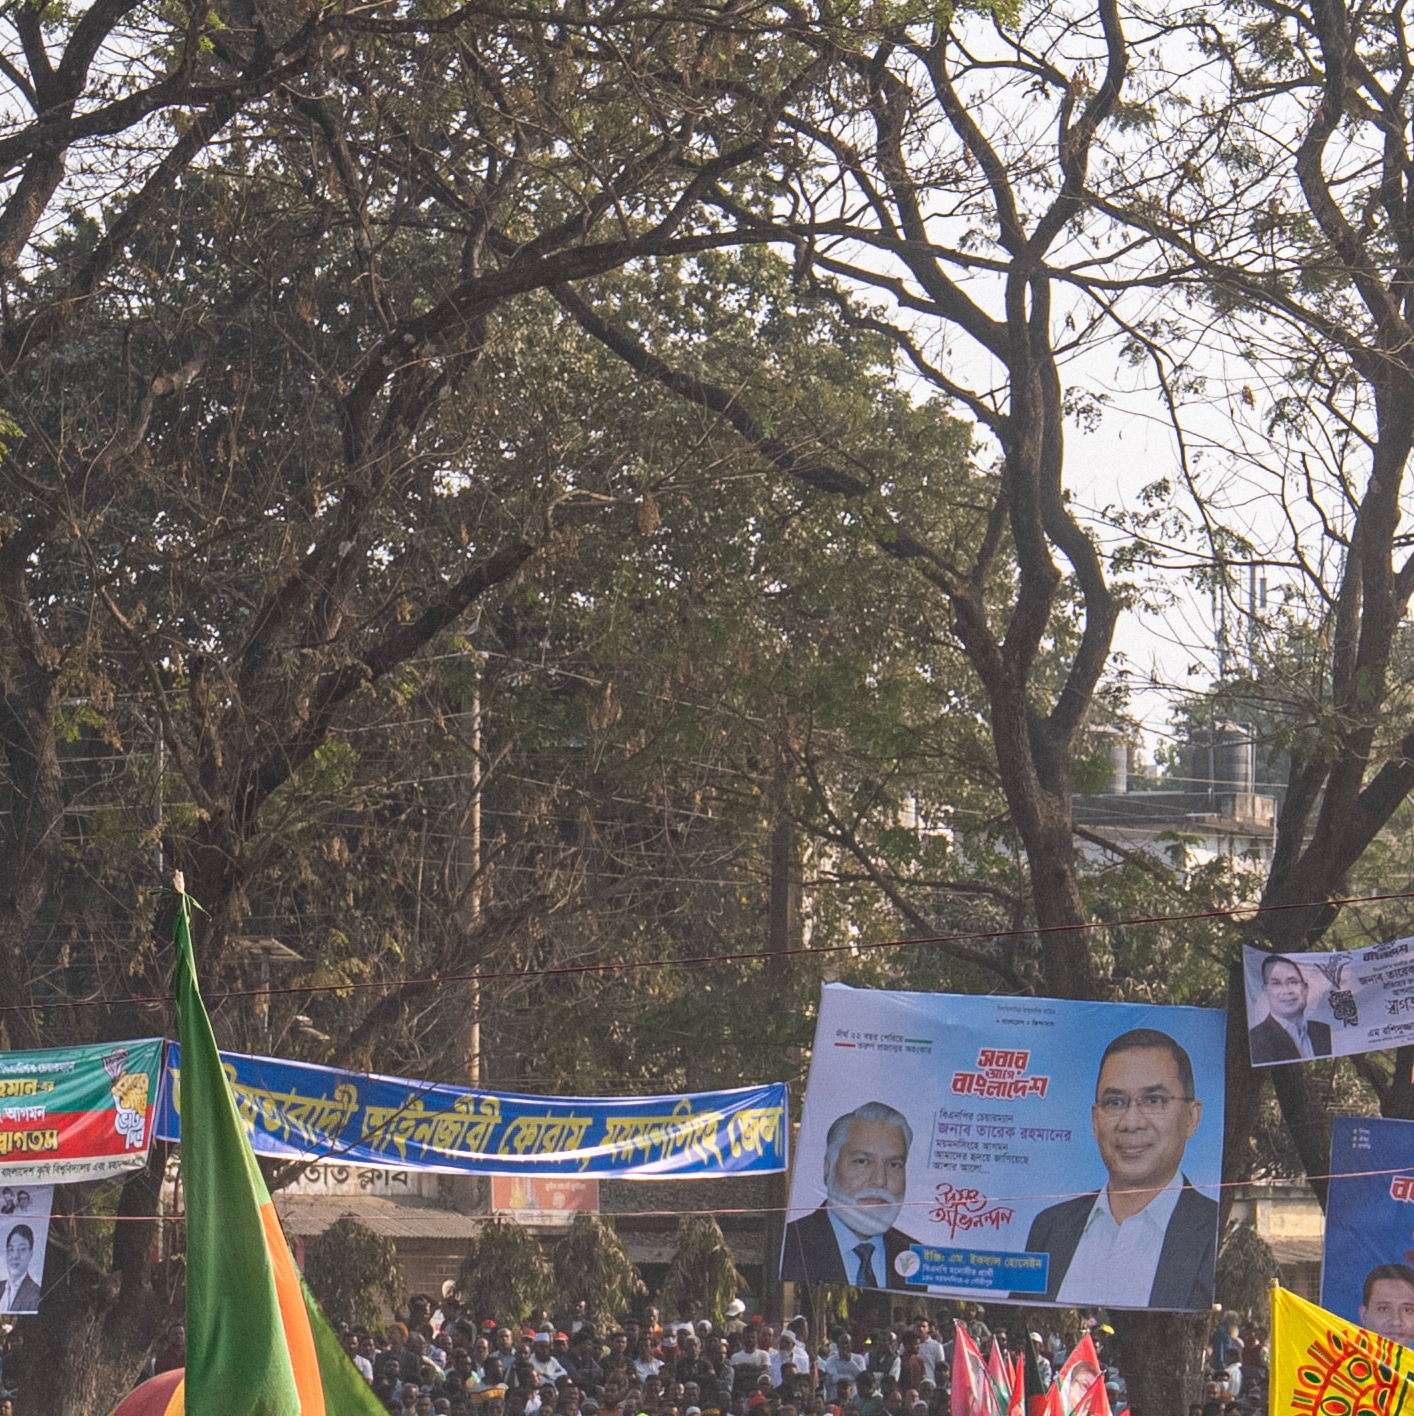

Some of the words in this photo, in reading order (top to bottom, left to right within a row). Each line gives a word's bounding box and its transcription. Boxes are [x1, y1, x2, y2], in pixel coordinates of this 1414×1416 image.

[977, 1049, 1030, 1071] সবার
[951, 1071, 1050, 1099] বাংলাদেশ
[4, 1105, 46, 1121] আগমন
[939, 1107, 974, 1122] বিএনপির
[938, 1121, 971, 1137] জনাব
[976, 1123, 1016, 1139] তারেক
[1020, 1127, 1072, 1142] রহমানের
